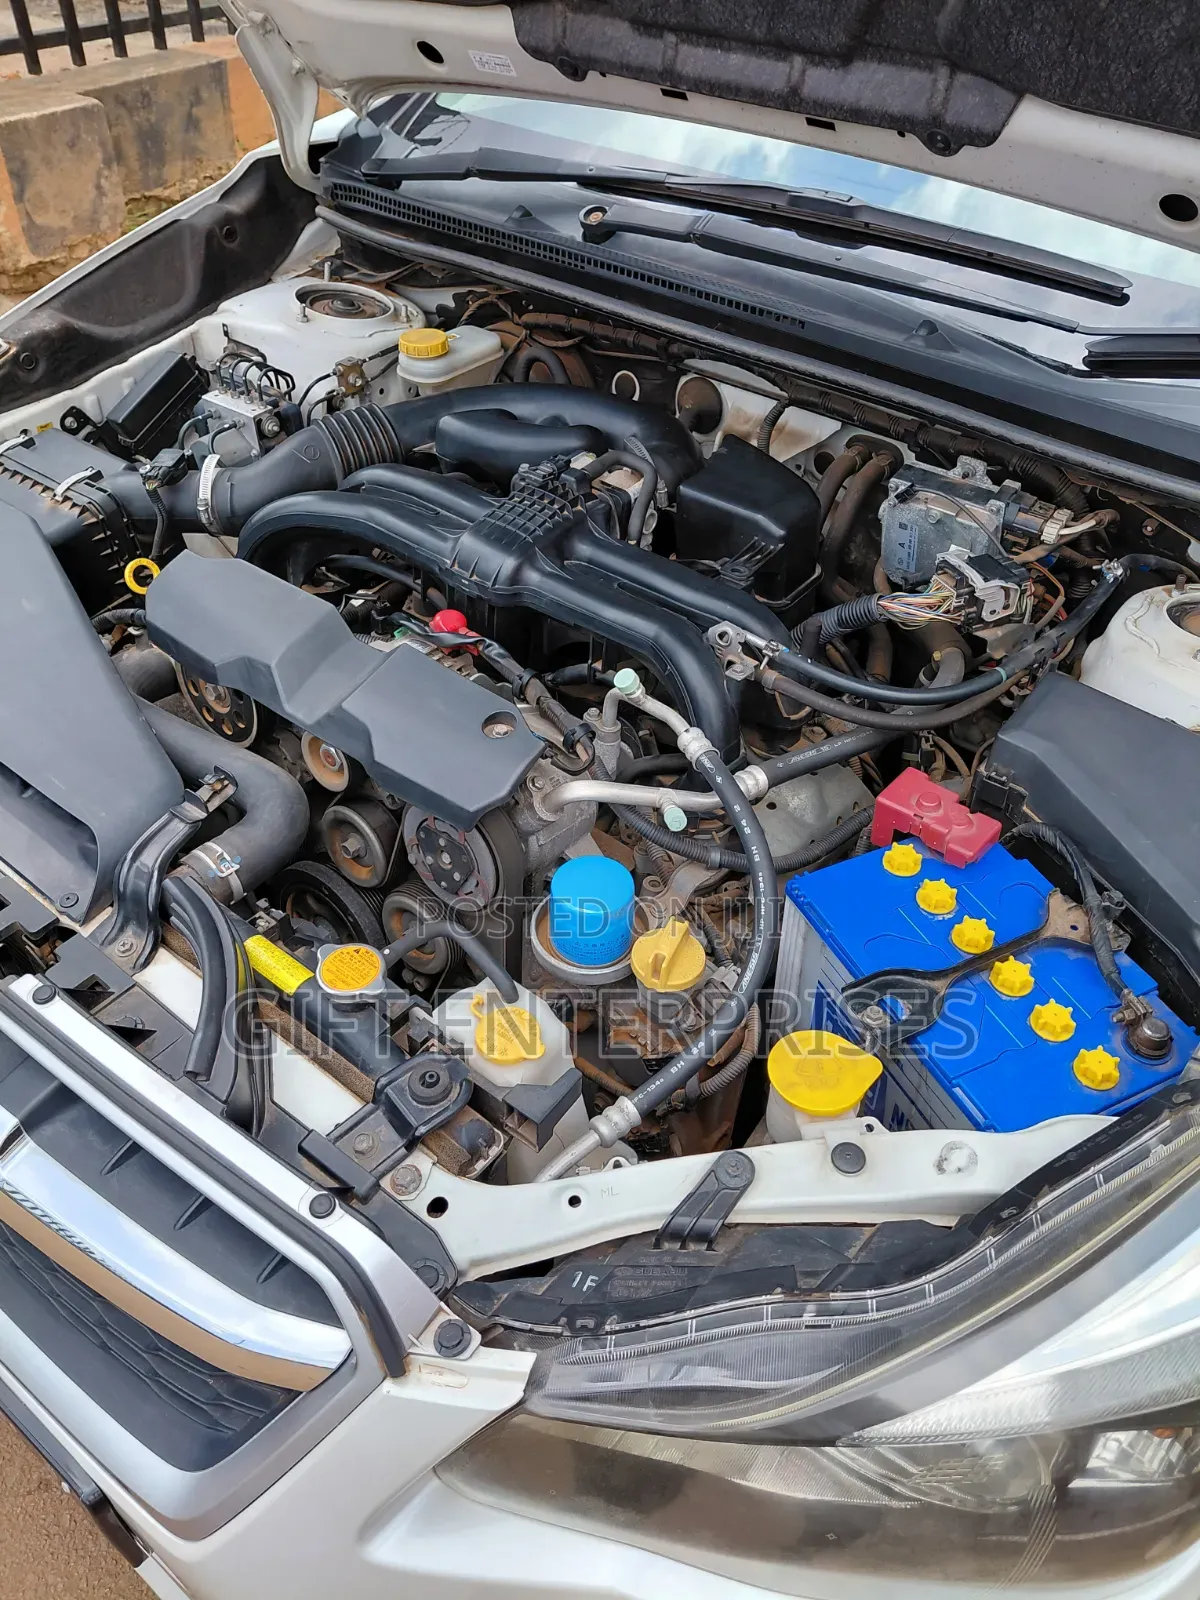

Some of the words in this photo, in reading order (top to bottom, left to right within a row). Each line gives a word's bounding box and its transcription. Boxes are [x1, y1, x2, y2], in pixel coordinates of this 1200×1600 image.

[898, 542, 906, 550] A
[740, 818, 752, 835] 24
[751, 845, 761, 862] BH
[691, 1041, 705, 1055] 24
[670, 1060, 685, 1074] BH
